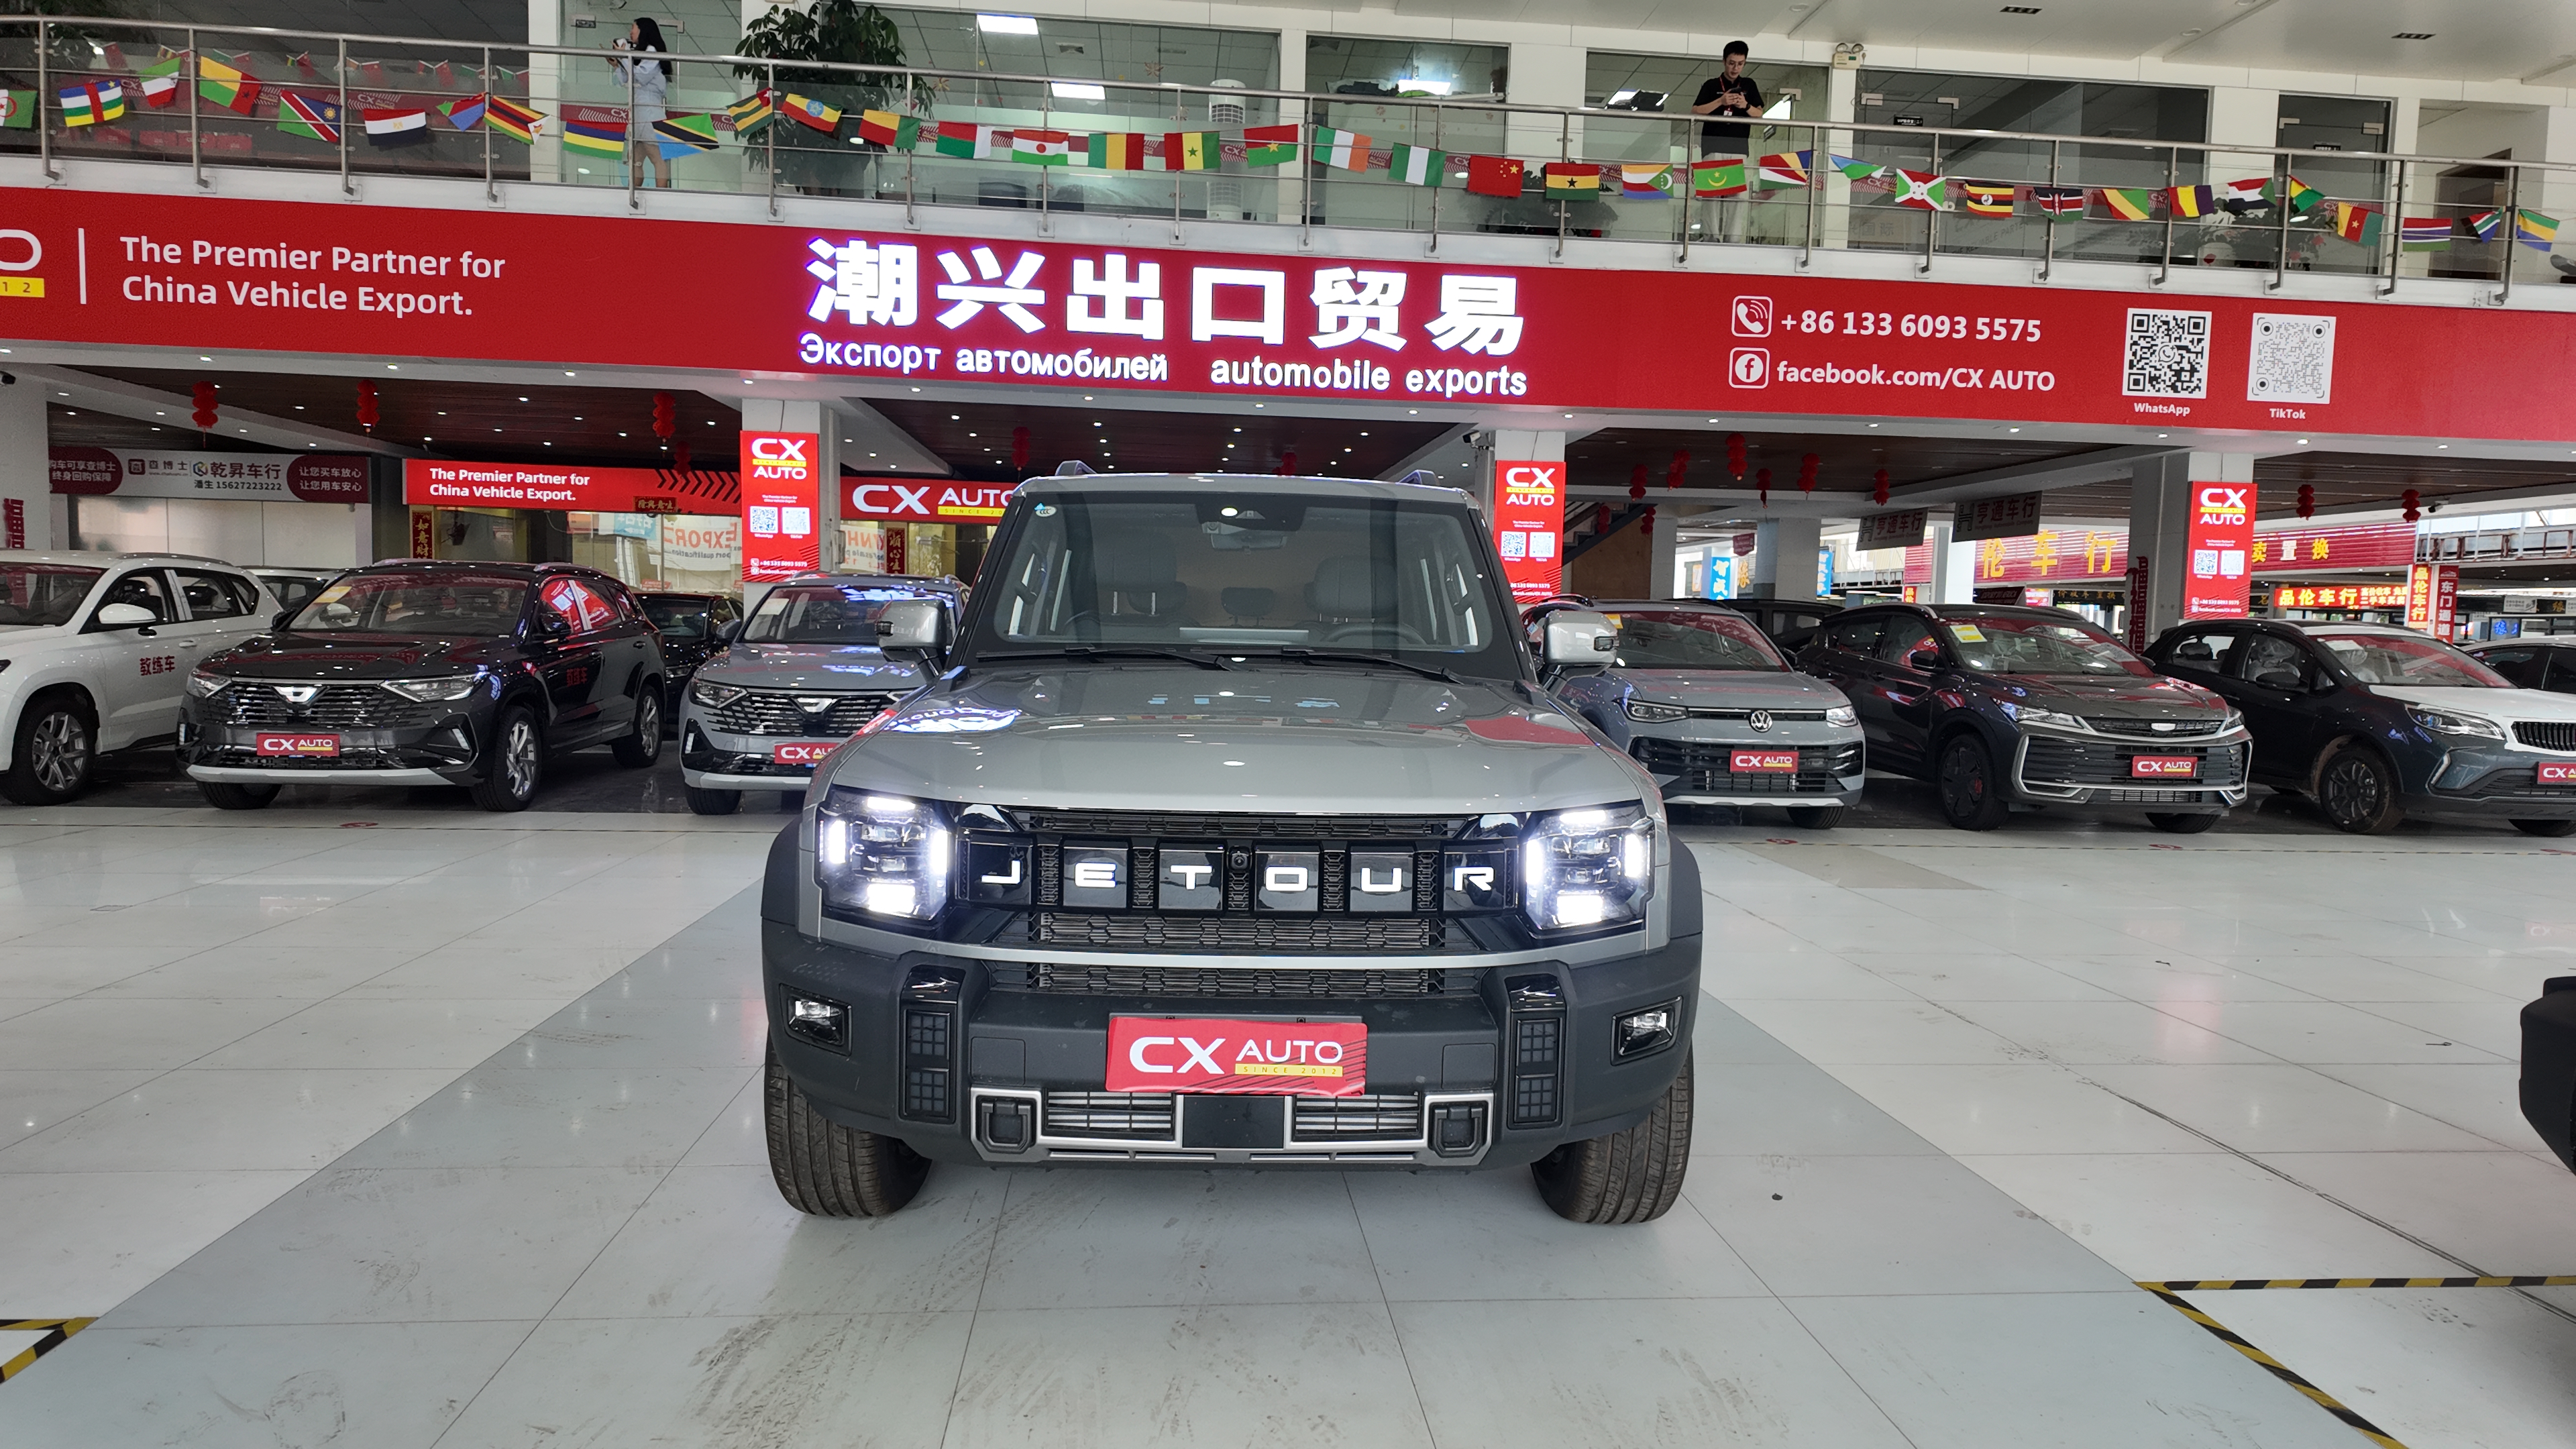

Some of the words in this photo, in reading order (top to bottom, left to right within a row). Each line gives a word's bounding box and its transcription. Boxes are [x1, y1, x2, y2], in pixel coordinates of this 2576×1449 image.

[119, 235, 182, 264] The
[193, 240, 322, 270] Premier
[332, 246, 451, 276] Partner
[459, 250, 506, 278] for
[123, 274, 217, 305] China
[226, 280, 347, 310] Vehicle
[358, 286, 472, 319] Export.
[806, 237, 1525, 356] 潮兴出口贸易
[1781, 310, 1835, 334] +86
[1843, 311, 1892, 336] 133
[1900, 314, 1967, 339] 6093
[1976, 317, 2041, 342] 5575
[799, 333, 942, 375] Экспорт
[956, 347, 1169, 382] автомобилей
[1210, 355, 1391, 390] automobile
[1405, 365, 1527, 398] exports
[1776, 360, 1984, 390] facebook.com/CX
[1988, 369, 2055, 392] AUTO
[2133, 402, 2191, 417] WhatsApp
[2269, 407, 2306, 420] TikTok
[751, 437, 807, 461] CX
[299, 466, 362, 478] 让您买车放心
[429, 468, 456, 481] The
[459, 469, 514, 483] Premier
[516, 471, 567, 484] Partner
[569, 473, 590, 486] for
[753, 466, 808, 480] AUTO
[1505, 467, 1556, 488] CX
[299, 480, 363, 492] 让您用车安心
[429, 483, 470, 497] China
[472, 485, 524, 499] Vehicle
[527, 488, 577, 502] Export.
[853, 484, 930, 515] CX
[1506, 493, 1555, 506] AUTO
[2200, 488, 2247, 508] CX
[1977, 496, 2037, 524] 亨通车行
[2200, 513, 2246, 525] AUTO
[1876, 512, 1923, 535] 亨通车行
[2278, 588, 2357, 606] 品伦车行
[2411, 567, 2429, 621] 品伦车行
[2437, 580, 2455, 636] 东门通道
[140, 655, 176, 676] 教练车
[263, 739, 295, 751] CX
[297, 739, 333, 747] AUTO
[780, 747, 811, 759] CX
[1735, 755, 1762, 767] CX
[2137, 761, 2163, 772] CX
[2164, 761, 2192, 769] AUTO
[2542, 767, 2567, 778] CX
[981, 859, 1495, 892] JETOUR
[1129, 1036, 1226, 1075] CX
[1236, 1039, 1343, 1064] AUTO
[1243, 1066, 1289, 1074] SINCE
[1301, 1067, 1337, 1075] 2012
